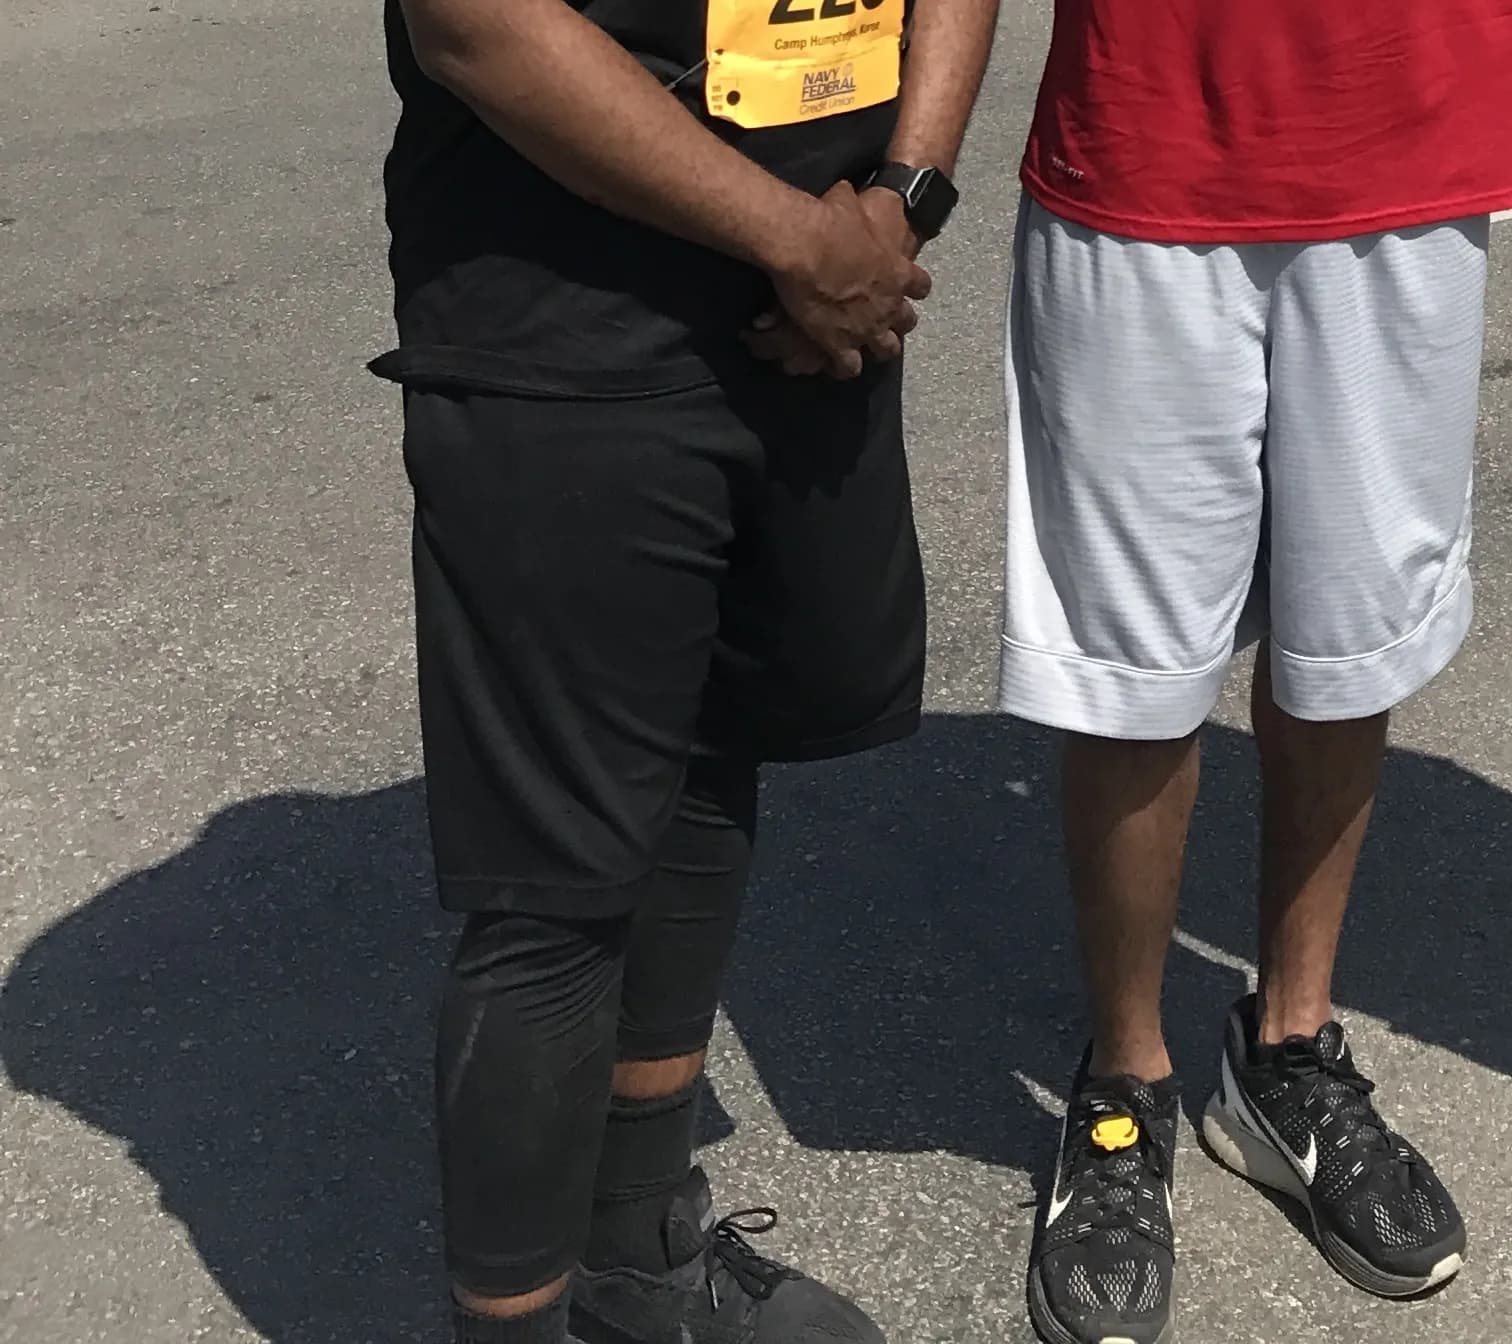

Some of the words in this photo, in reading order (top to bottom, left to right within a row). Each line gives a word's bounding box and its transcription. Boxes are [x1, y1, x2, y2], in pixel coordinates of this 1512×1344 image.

[775, 38, 807, 51] Camp
[803, 66, 841, 85] NAVY
[802, 77, 857, 101] FEDERAL
